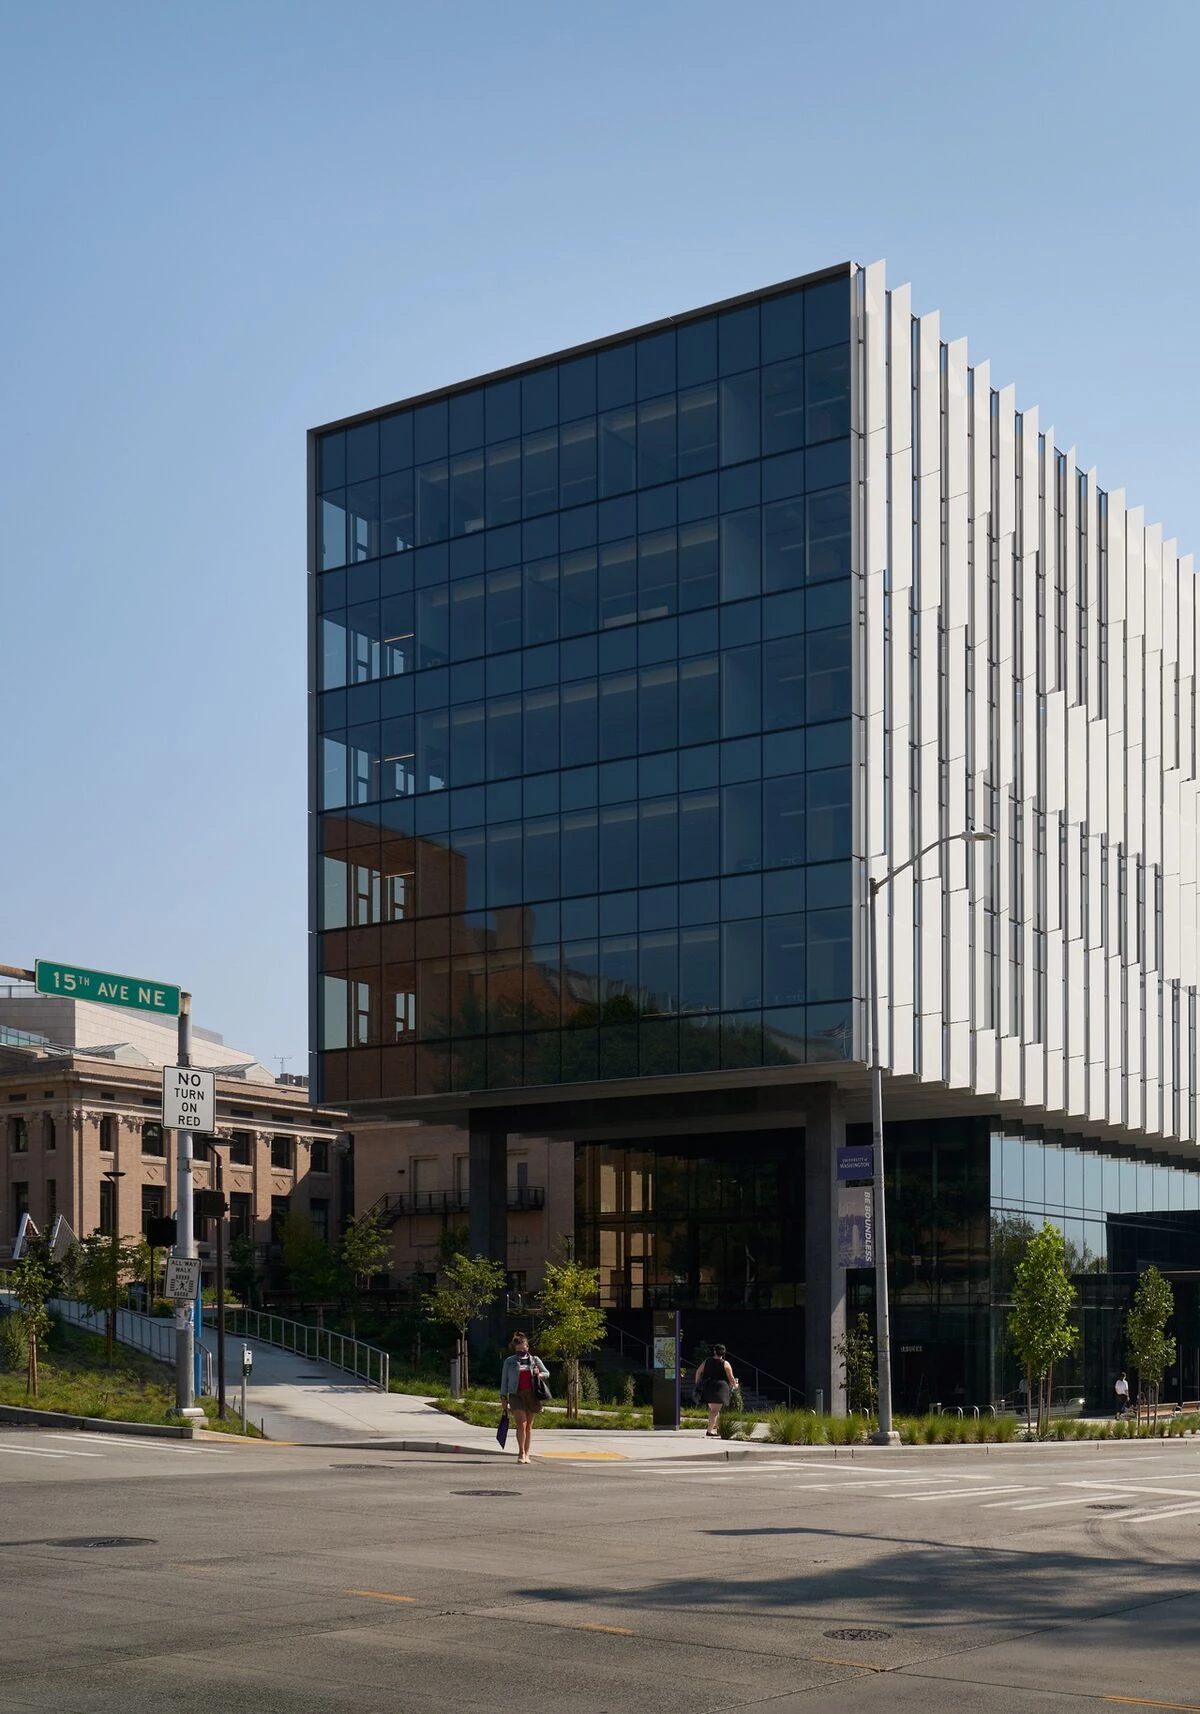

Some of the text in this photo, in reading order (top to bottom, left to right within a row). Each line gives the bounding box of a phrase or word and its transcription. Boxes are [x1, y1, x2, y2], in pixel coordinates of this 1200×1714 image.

[53, 971, 166, 1007] 15TH AVE NE
[178, 1072, 201, 1086] NO
[174, 1087, 205, 1100] TURN
[181, 1103, 197, 1114] ON
[178, 1115, 201, 1127] RED
[864, 1192, 872, 1262] BE BOUNDLESS
[667, 1311, 675, 1319] W
